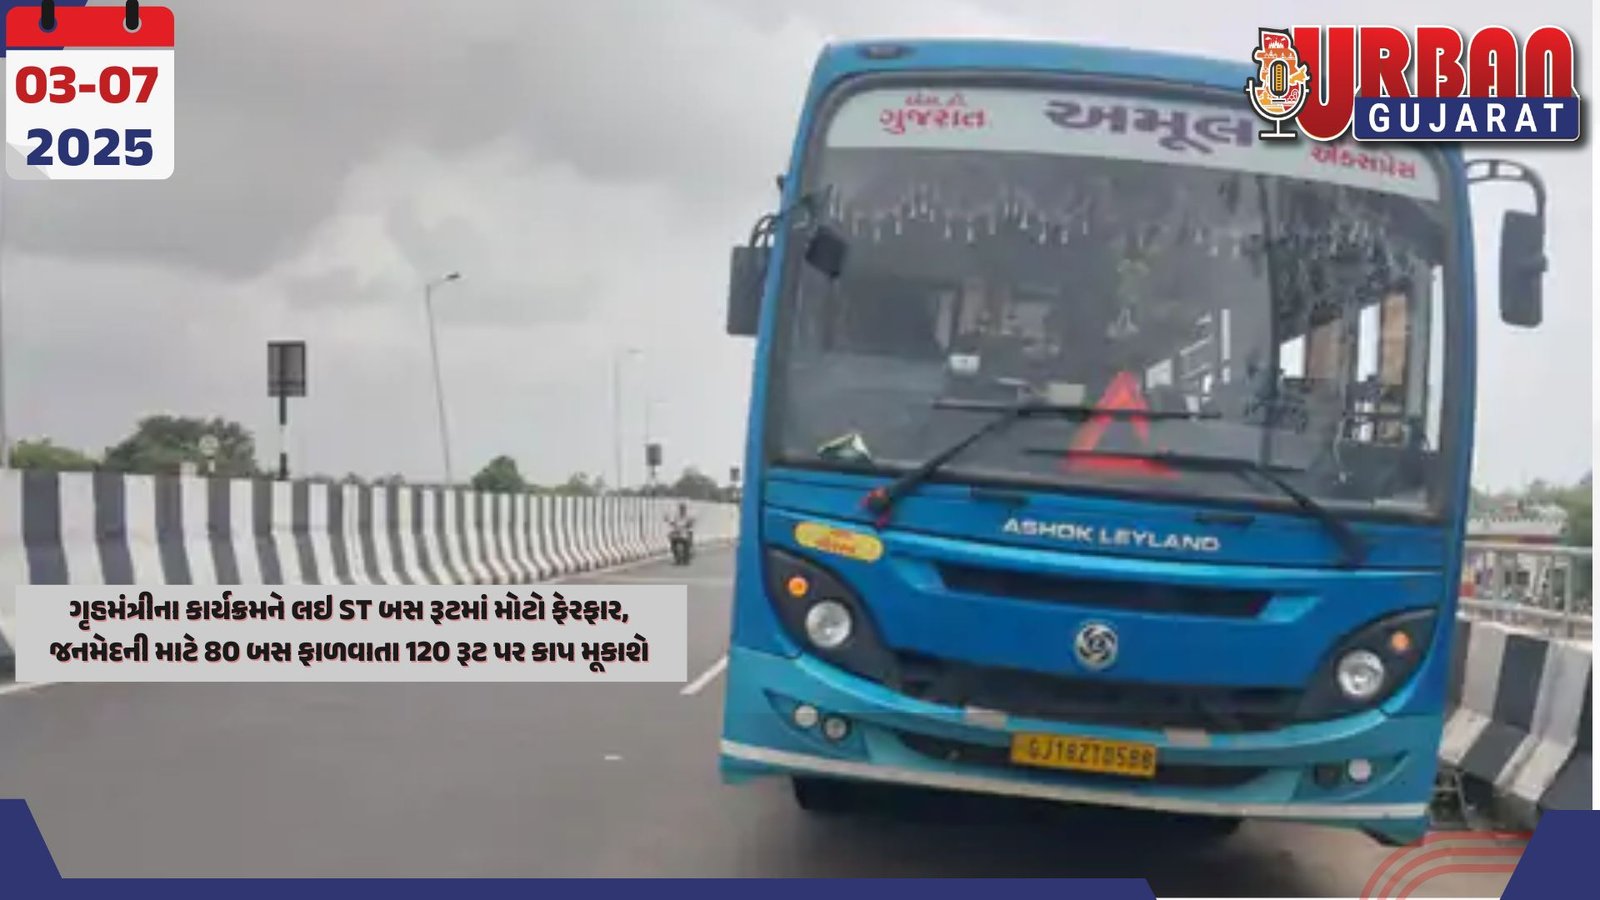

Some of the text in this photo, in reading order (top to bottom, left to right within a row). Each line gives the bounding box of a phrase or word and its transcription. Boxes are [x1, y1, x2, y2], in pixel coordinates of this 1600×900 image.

[879, 107, 986, 135] ગુજરાત
[1045, 99, 1253, 154] અમૂલ
[1003, 517, 1221, 552] ASHOK LEYLAND
